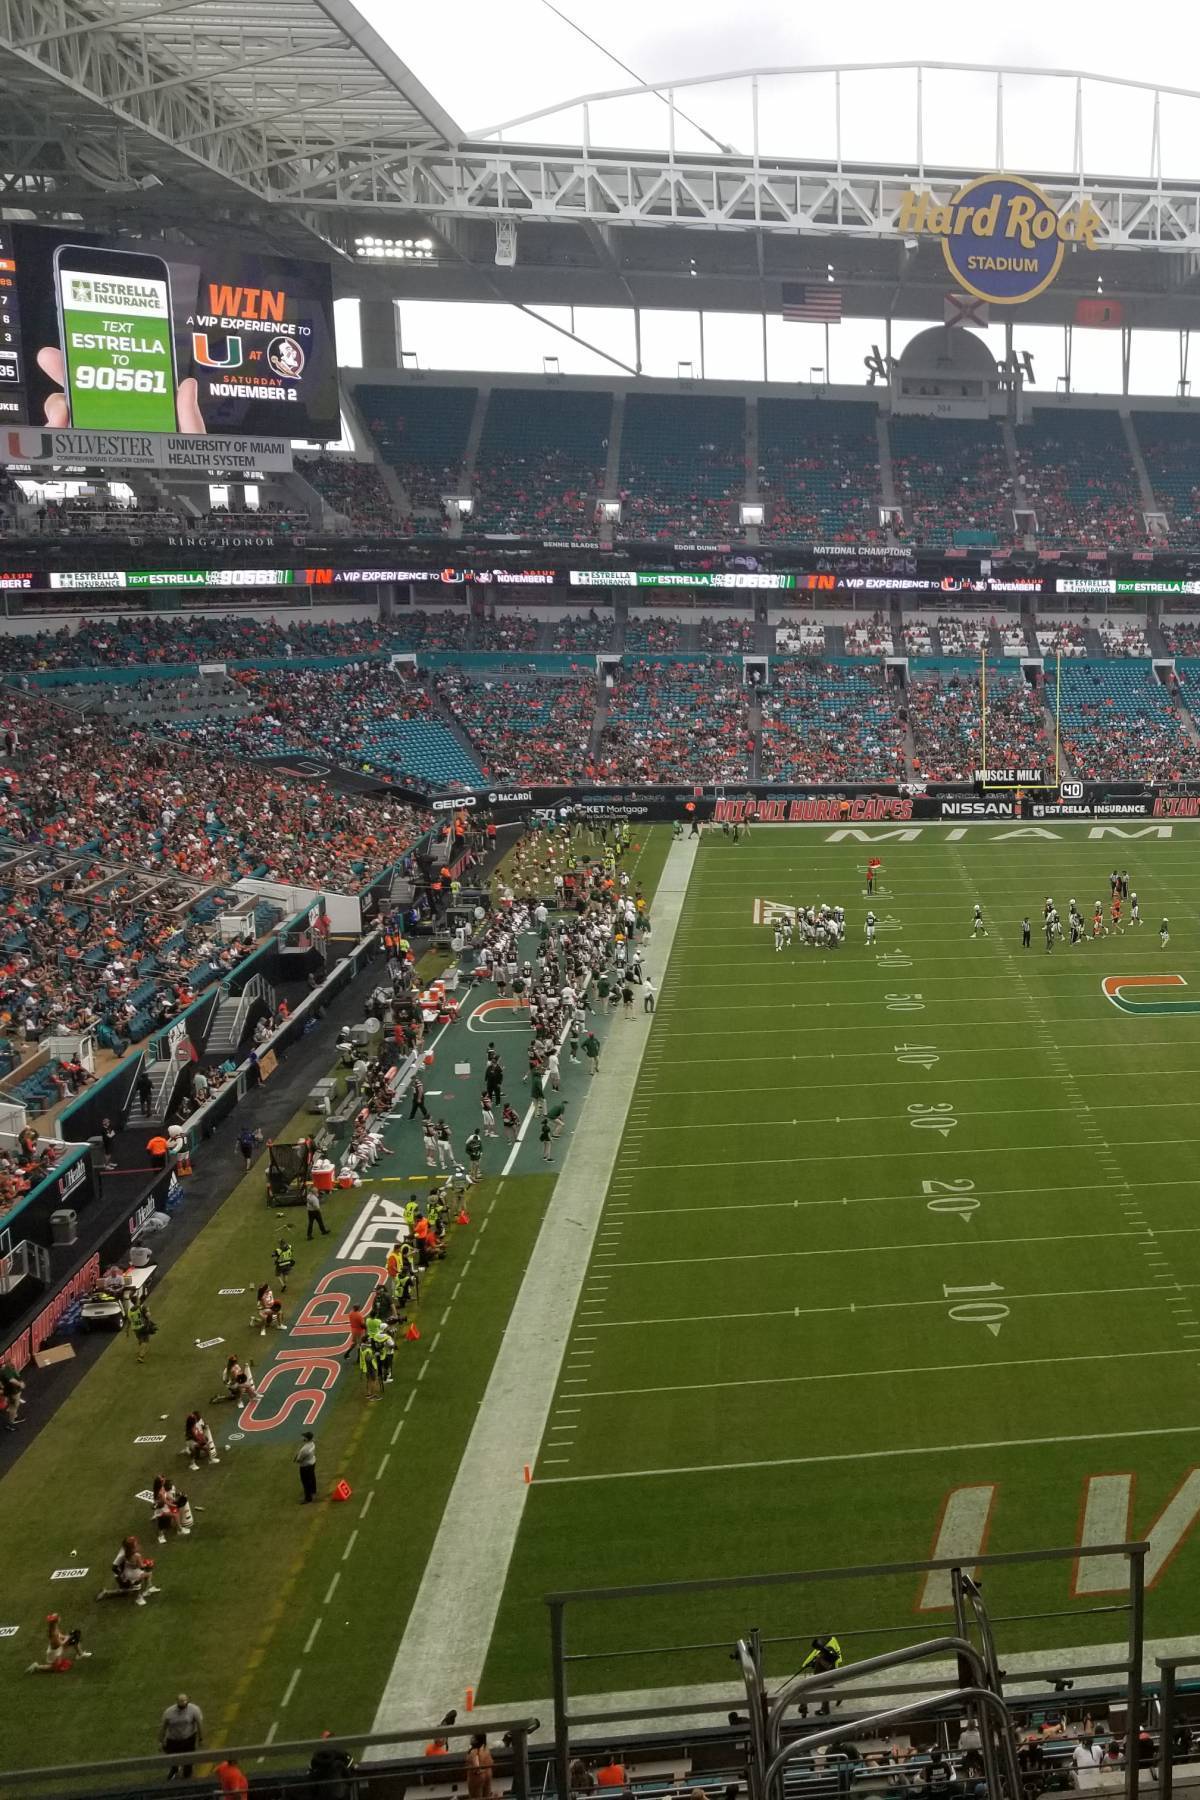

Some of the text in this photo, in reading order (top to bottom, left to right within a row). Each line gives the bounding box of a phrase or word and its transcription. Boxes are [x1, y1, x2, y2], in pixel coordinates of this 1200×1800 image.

[899, 191, 1100, 250] Hard Rock
[967, 256, 1039, 272] STADIUM
[93, 281, 159, 298] ESTRELLA
[94, 294, 161, 309] INSURANCE
[209, 284, 286, 321] WIN
[102, 320, 134, 333] TEXT
[186, 315, 311, 336] A VIP EXPERIENCE TO
[72, 333, 165, 354] ESTRELLA
[112, 354, 129, 366] TO
[249, 351, 262, 360] AT
[75, 365, 167, 393] 90561
[223, 375, 283, 386] SATURDAY
[209, 383, 297, 400] NOVEMBER 2
[55, 434, 154, 456] SYLVESTER
[168, 438, 285, 454] UNIVERSITY OF MIAMI
[168, 454, 255, 467] HEALTH SYSTEM
[168, 537, 276, 546] RING HONOR
[813, 546, 913, 556] NATIONAL CHAMPIONS
[128, 574, 204, 584] TEXT ESTRELLA
[343, 572, 360, 582] VIP
[497, 574, 545, 583] NOVEMBER
[639, 575, 709, 585] TEXT ESTRELLA
[846, 578, 864, 587] VIP
[1117, 583, 1134, 591] TEXT
[1134, 583, 1180, 592] ESTRELLA
[975, 769, 1041, 782] MUSCLE MILK
[1063, 784, 1080, 796] 40
[432, 796, 477, 810] GEICO
[942, 803, 1013, 815] NISSAN
[606, 805, 649, 815] Mortgage
[1045, 805, 1146, 815] ESTRELLA INSURANCE
[885, 993, 926, 1011] 50
[895, 1043, 940, 1064] 40
[907, 1103, 957, 1128] 30
[922, 1178, 981, 1212] 20
[943, 1282, 1010, 1322] 10
[54, 1569, 86, 1578] NOISE
